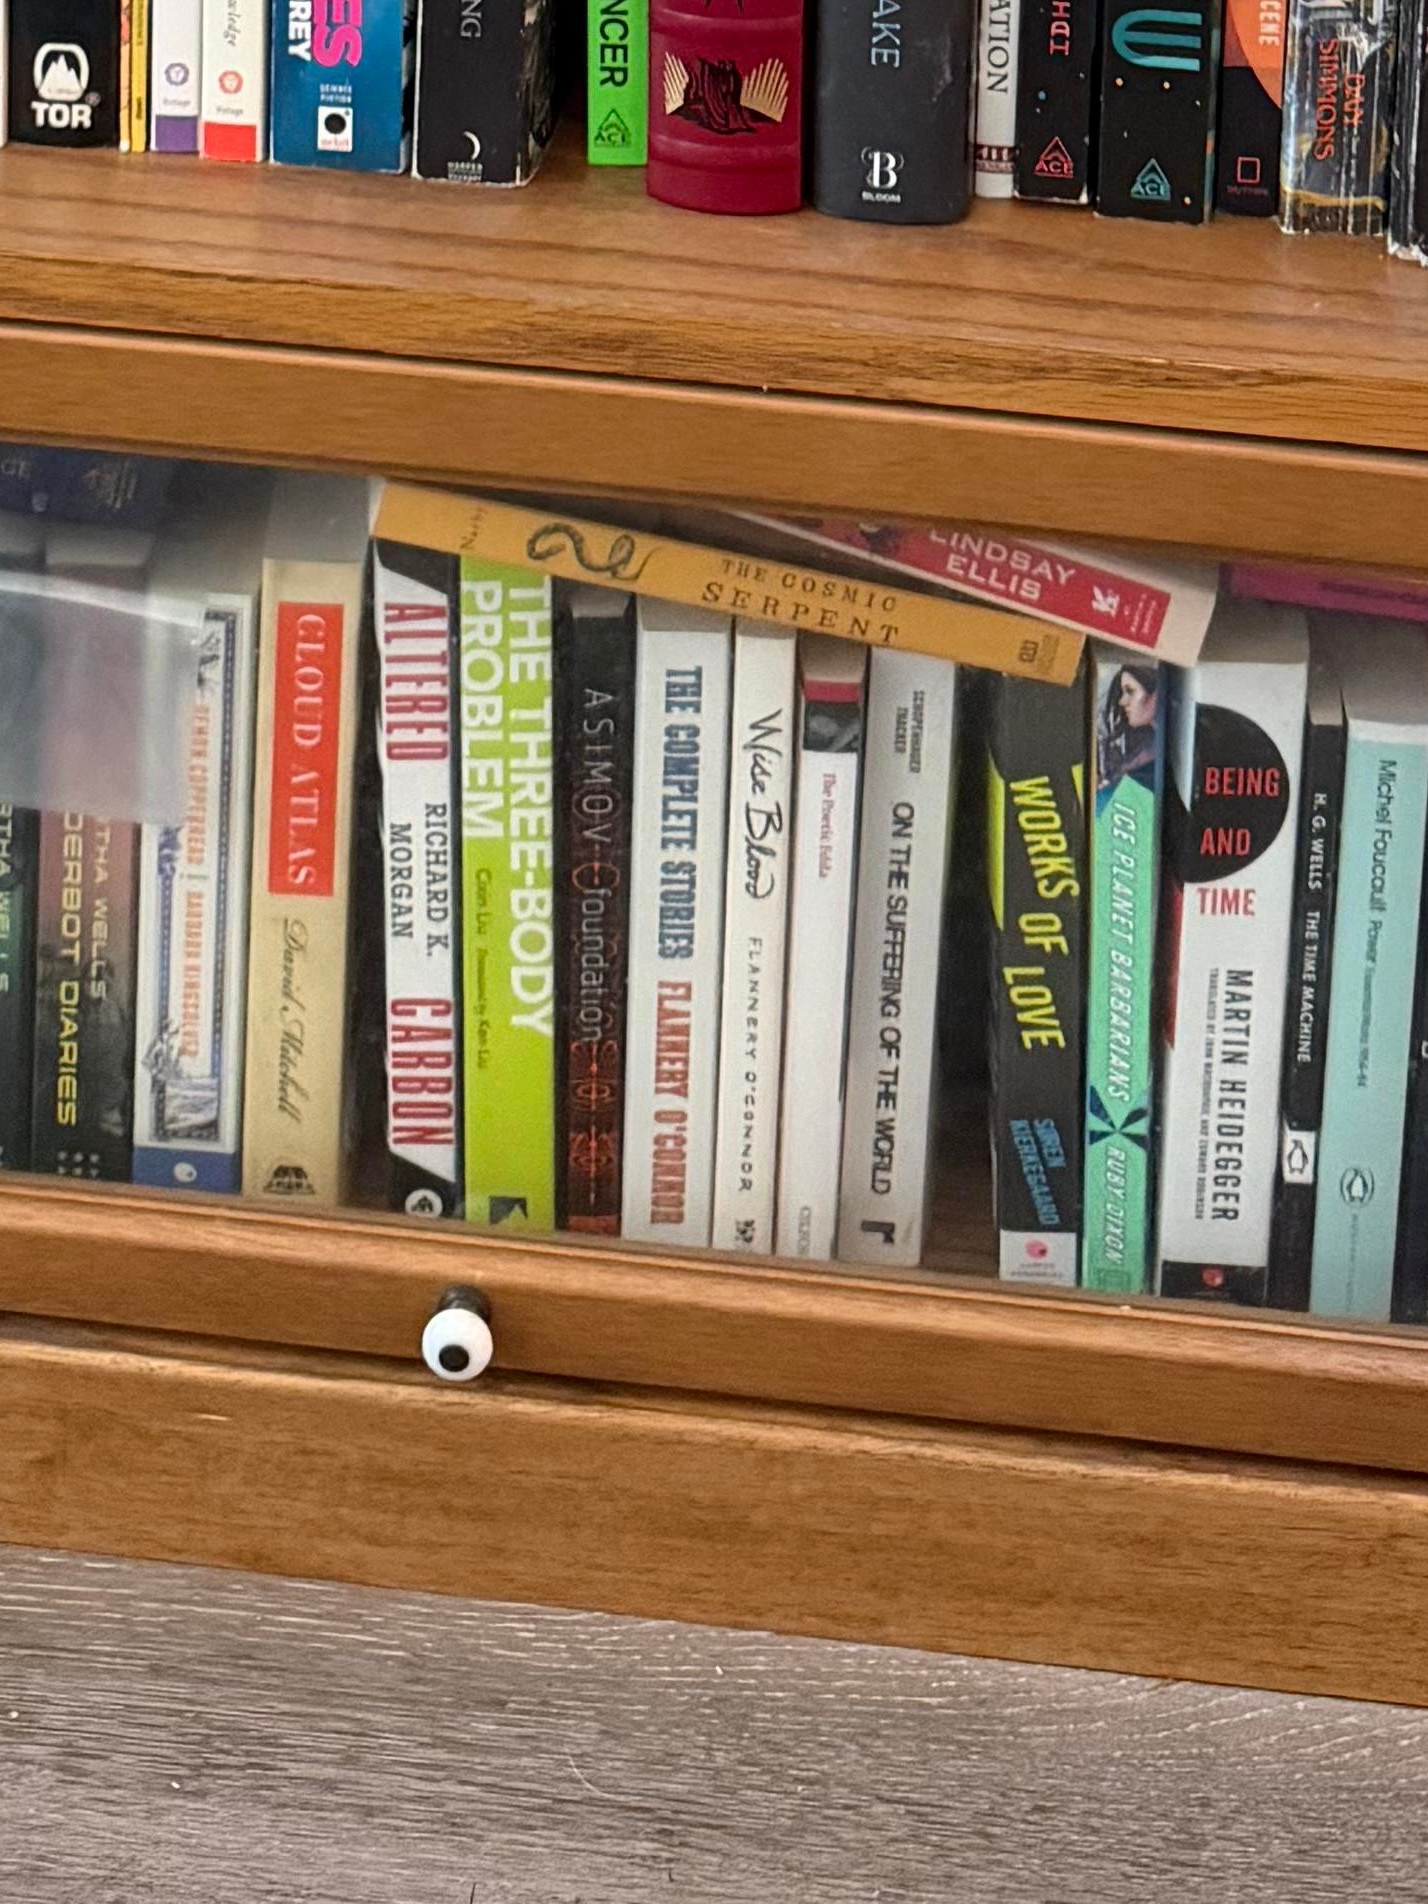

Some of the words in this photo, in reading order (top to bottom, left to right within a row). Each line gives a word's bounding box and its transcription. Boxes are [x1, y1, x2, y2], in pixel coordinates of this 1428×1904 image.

[701, 582, 898, 644] SERPENT
[723, 559, 766, 575] THE
[781, 574, 898, 611] COSMIC
[290, 615, 326, 747] CLOUD
[383, 603, 450, 761] ALTERED
[1204, 767, 1280, 796] BEING
[285, 770, 320, 884] ATLAS
[1201, 828, 1251, 855] AND
[1196, 888, 1255, 915] TIME
[389, 998, 453, 1146] CARBON
